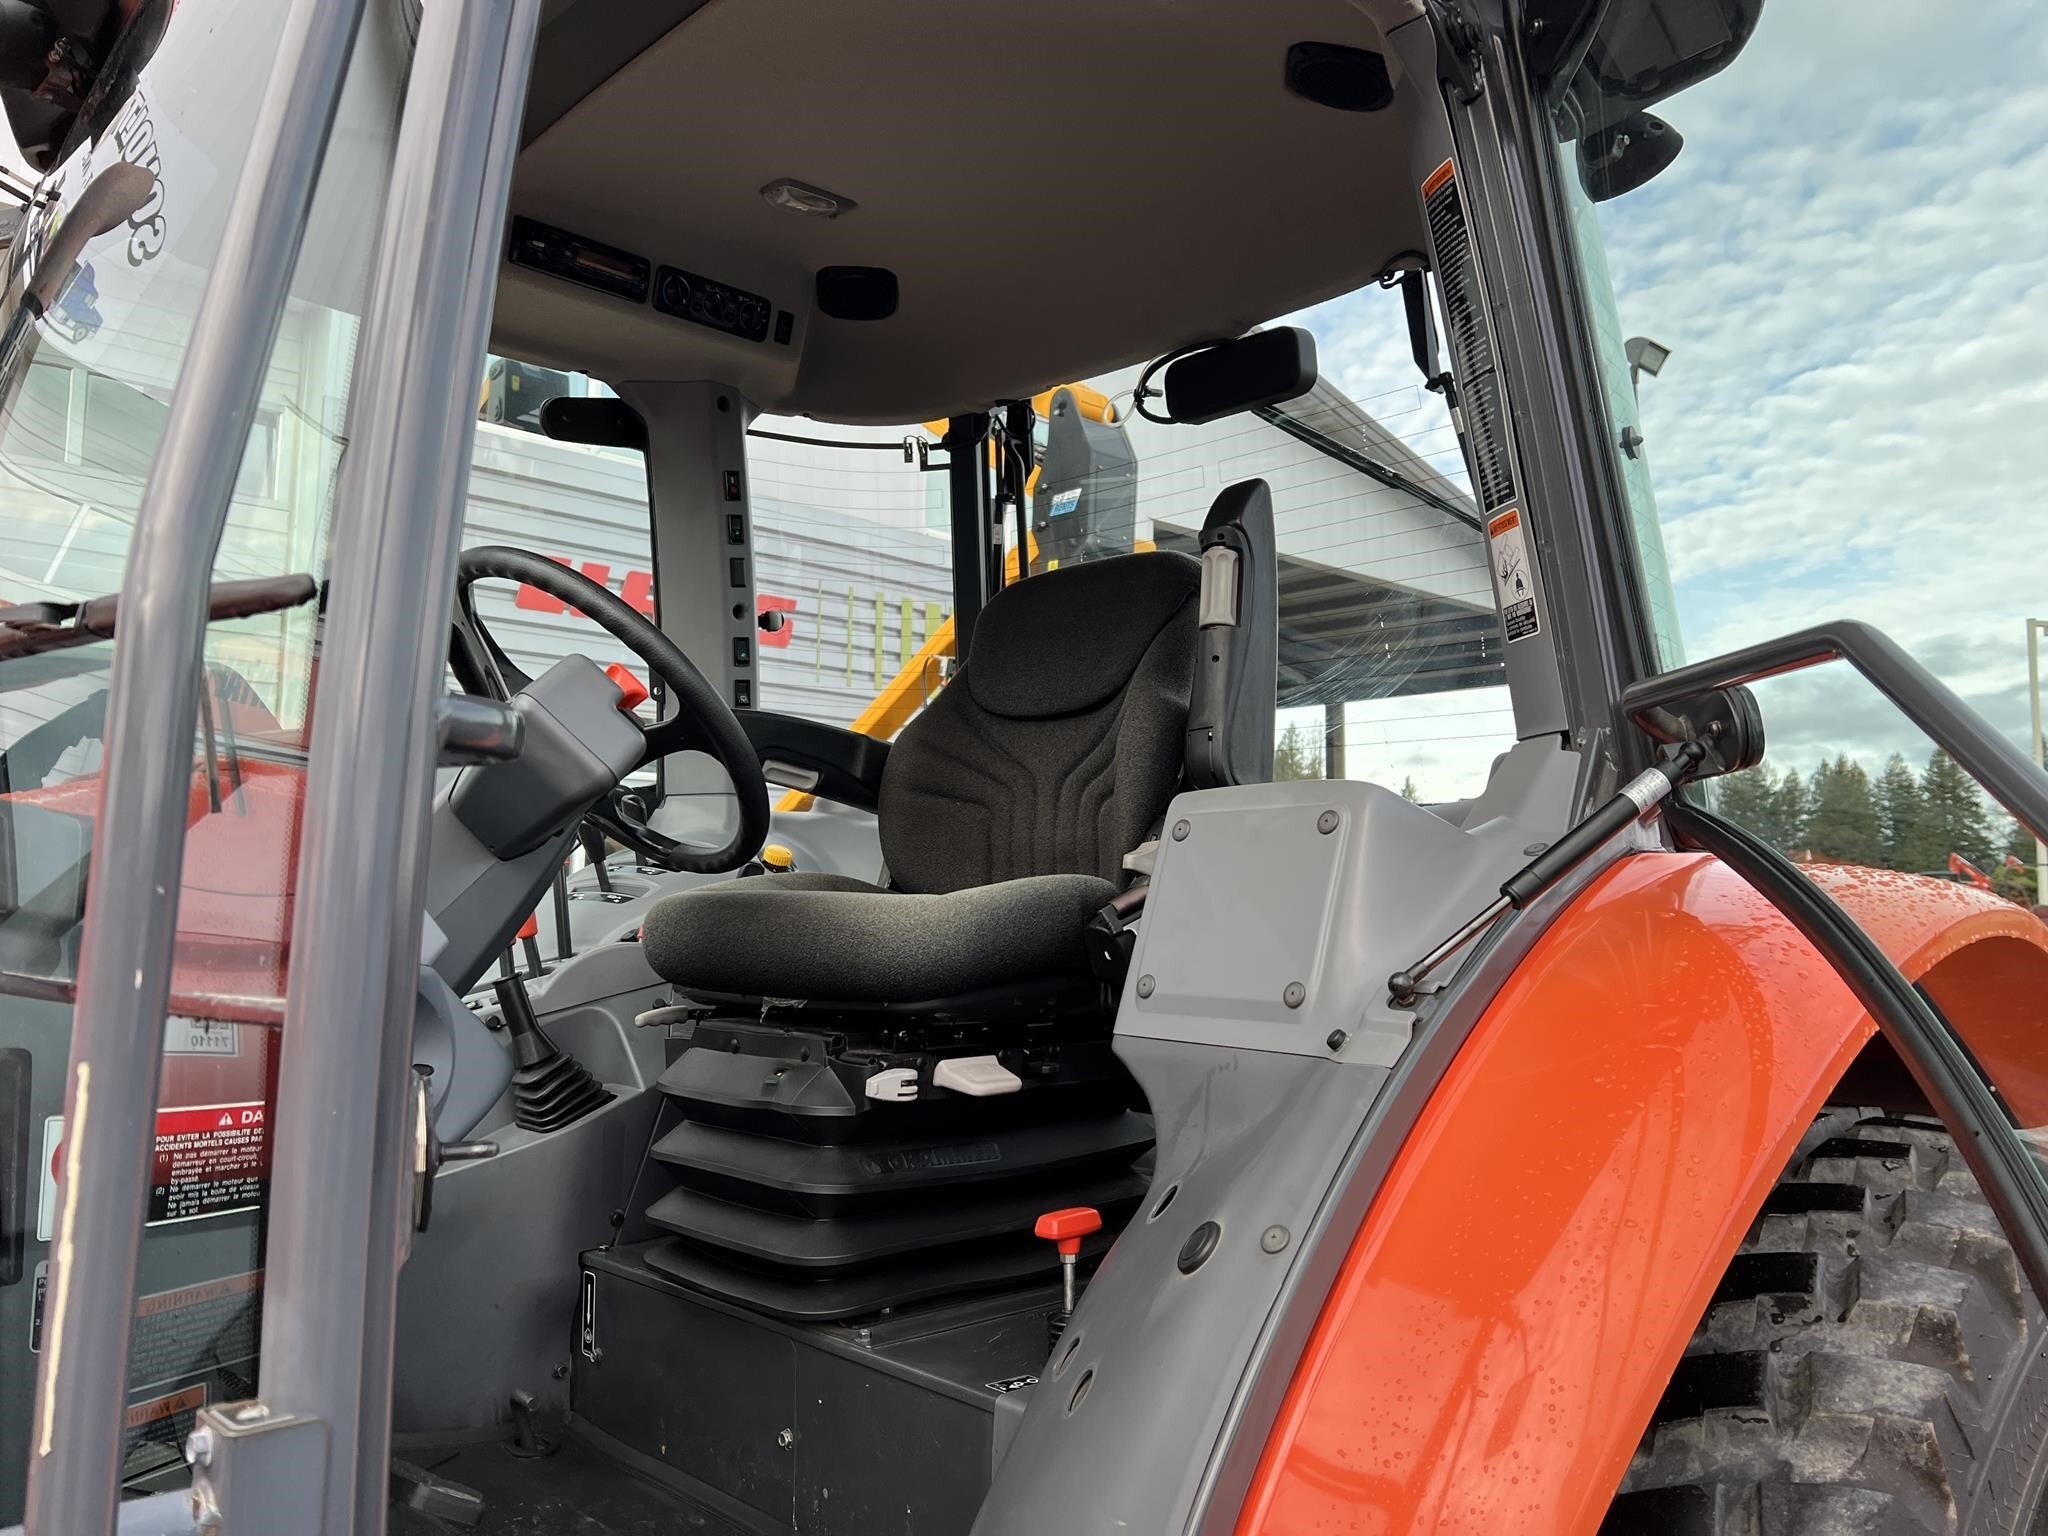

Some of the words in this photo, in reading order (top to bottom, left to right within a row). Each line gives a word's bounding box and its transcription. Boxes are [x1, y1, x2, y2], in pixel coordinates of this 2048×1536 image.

[156, 1135, 175, 1143] POUR
[177, 1133, 199, 1141] EVITER
[213, 1129, 250, 1138] POSSIBILITE
[155, 1141, 192, 1151] ACCIDENTS
[194, 1138, 223, 1148] MORTELS
[224, 1136, 249, 1145] CAUSES
[160, 1154, 168, 1163] (1)
[206, 1165, 212, 1173] et
[215, 1162, 240, 1171] marcher
[156, 1187, 164, 1196] (2)
[169, 1193, 185, 1201] avoir
[168, 1202, 177, 1210] Ne
[179, 1199, 199, 1209] jamais
[167, 1210, 177, 1218] sur
